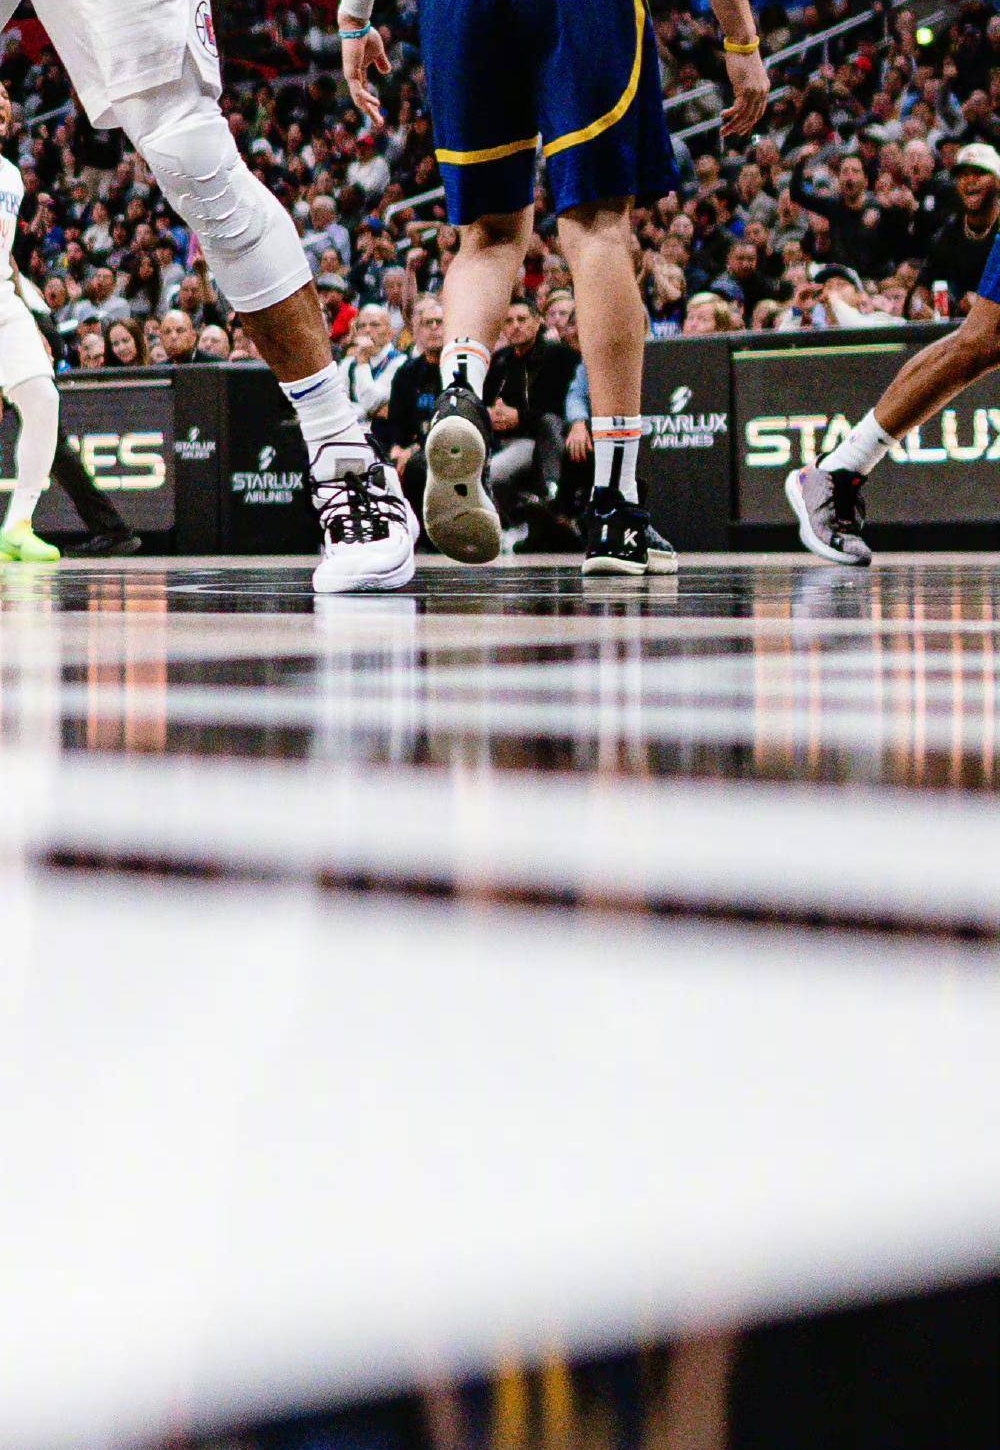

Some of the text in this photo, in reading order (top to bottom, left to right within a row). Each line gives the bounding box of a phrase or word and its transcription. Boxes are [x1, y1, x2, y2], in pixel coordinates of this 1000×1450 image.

[640, 413, 727, 435] STARLUX
[746, 409, 1000, 467] STALUX
[232, 472, 303, 491] STARLUX
